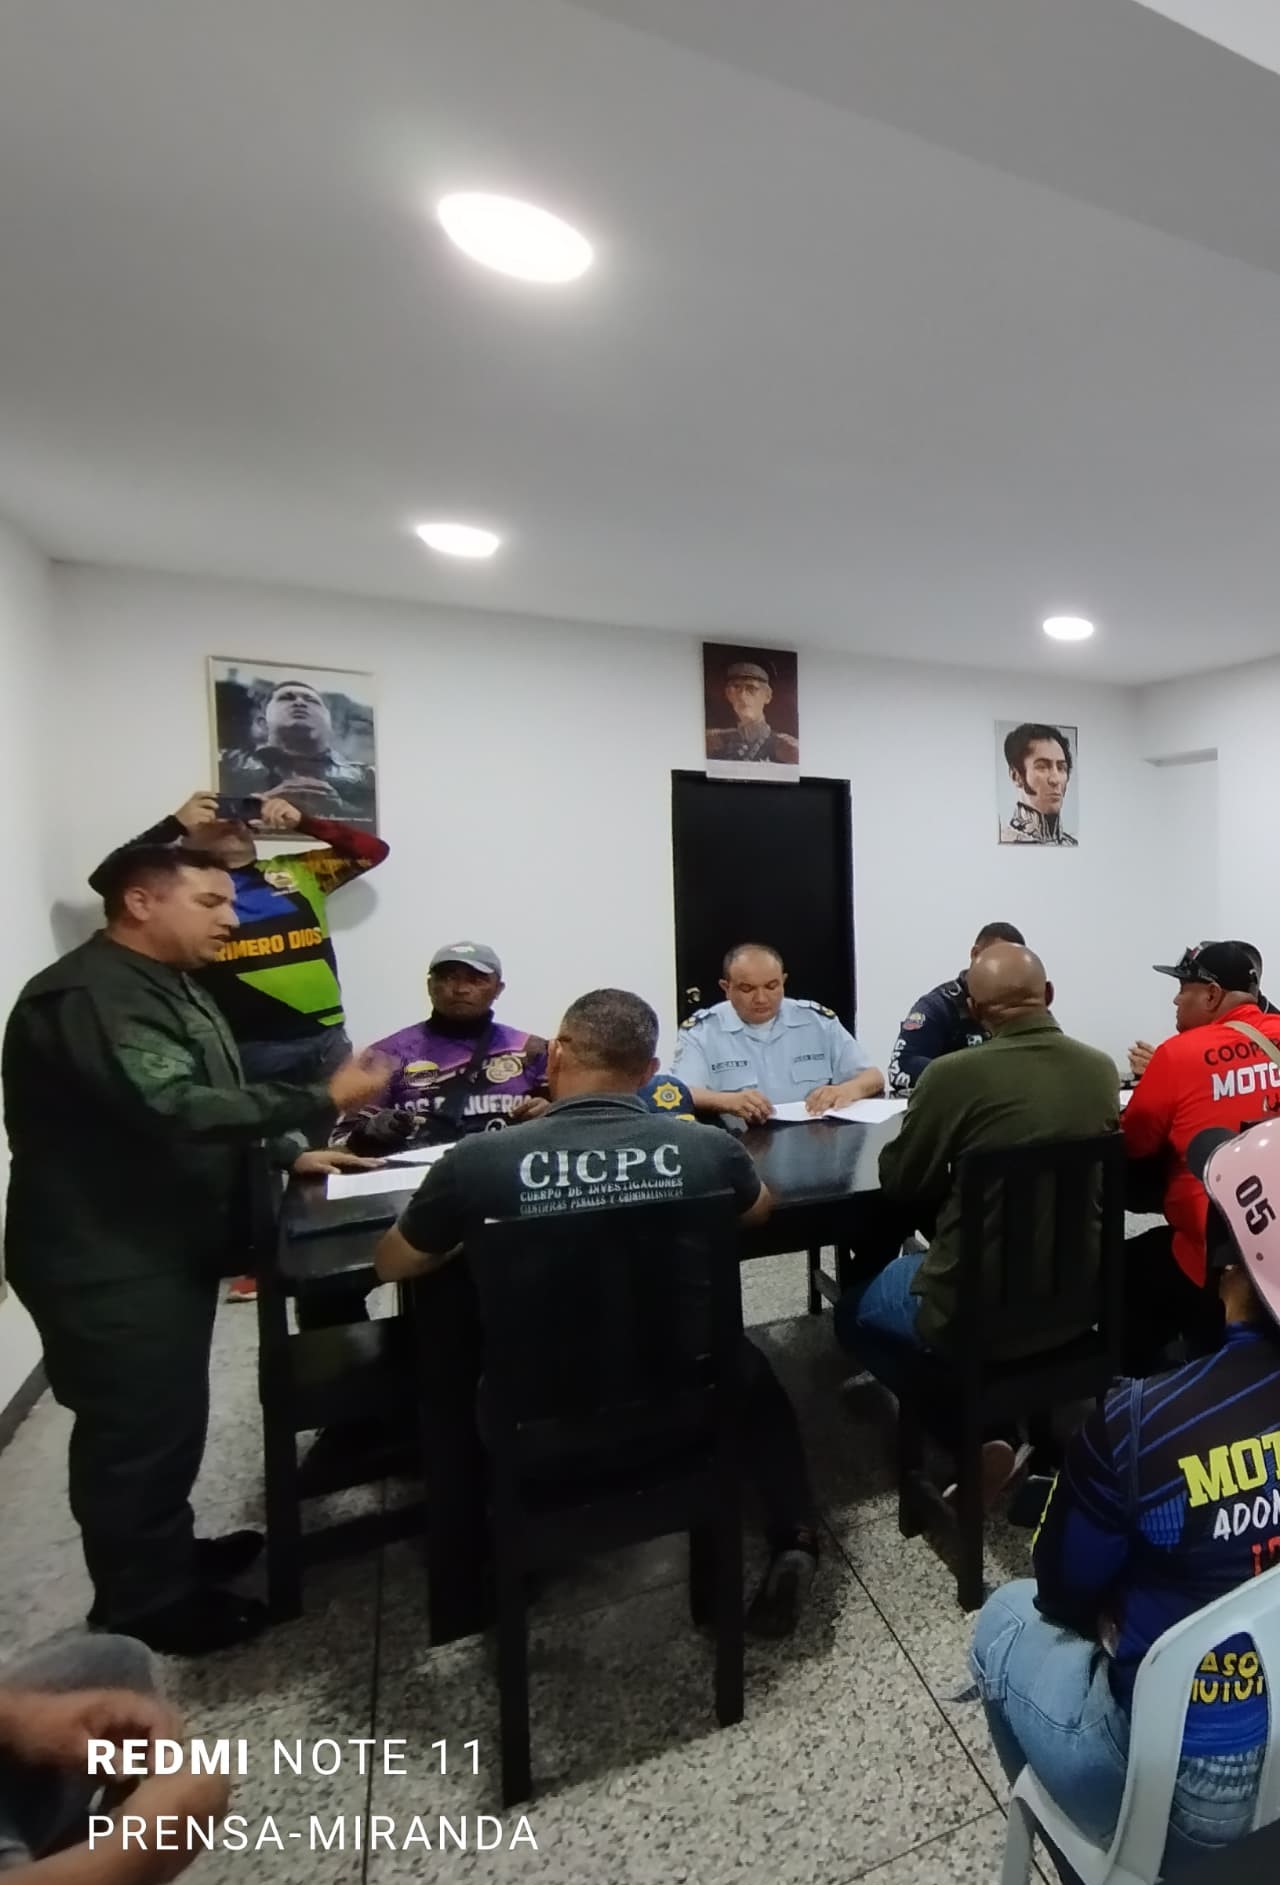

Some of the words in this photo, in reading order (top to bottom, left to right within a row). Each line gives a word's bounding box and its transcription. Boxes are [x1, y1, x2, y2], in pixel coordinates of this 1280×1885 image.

[287, 927, 322, 949] DIOS
[519, 1143, 683, 1189] CICPC
[519, 1189, 562, 1202] CUERPO
[567, 1186, 583, 1198] DE
[588, 1177, 684, 1195] INVESTIGACIONES
[1235, 1175, 1276, 1236] 05
